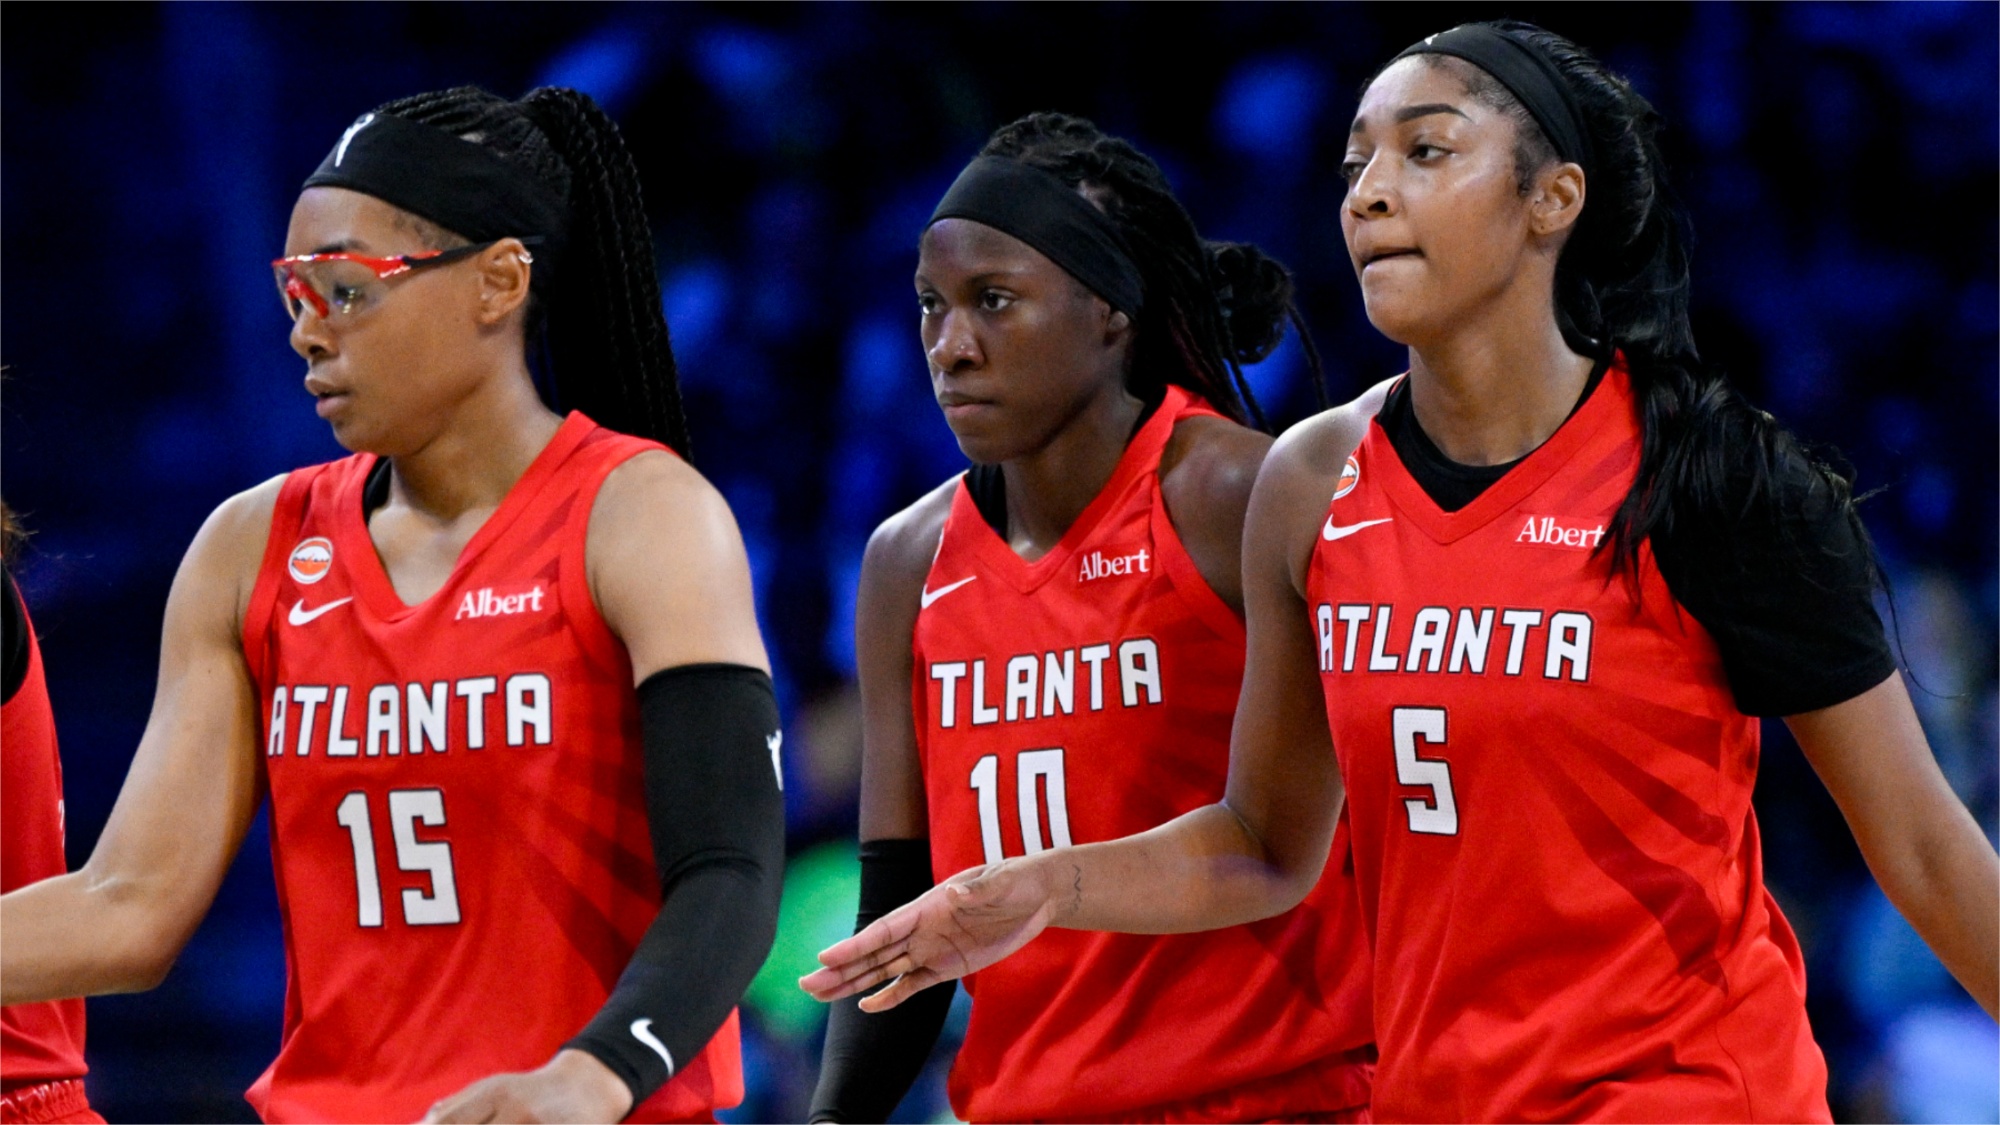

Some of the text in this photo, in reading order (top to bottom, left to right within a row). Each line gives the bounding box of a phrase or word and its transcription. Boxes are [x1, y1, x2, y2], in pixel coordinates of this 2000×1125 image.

[1078, 548, 1150, 583] Albert
[1515, 516, 1604, 548] Albert
[454, 585, 544, 621] Albert
[1316, 603, 1595, 683] ATLANTA
[267, 672, 553, 757] ATLANTA
[930, 636, 1163, 729] TLANTA
[969, 747, 1072, 866] 10
[1392, 706, 1459, 836] 5
[336, 787, 462, 927] 15
